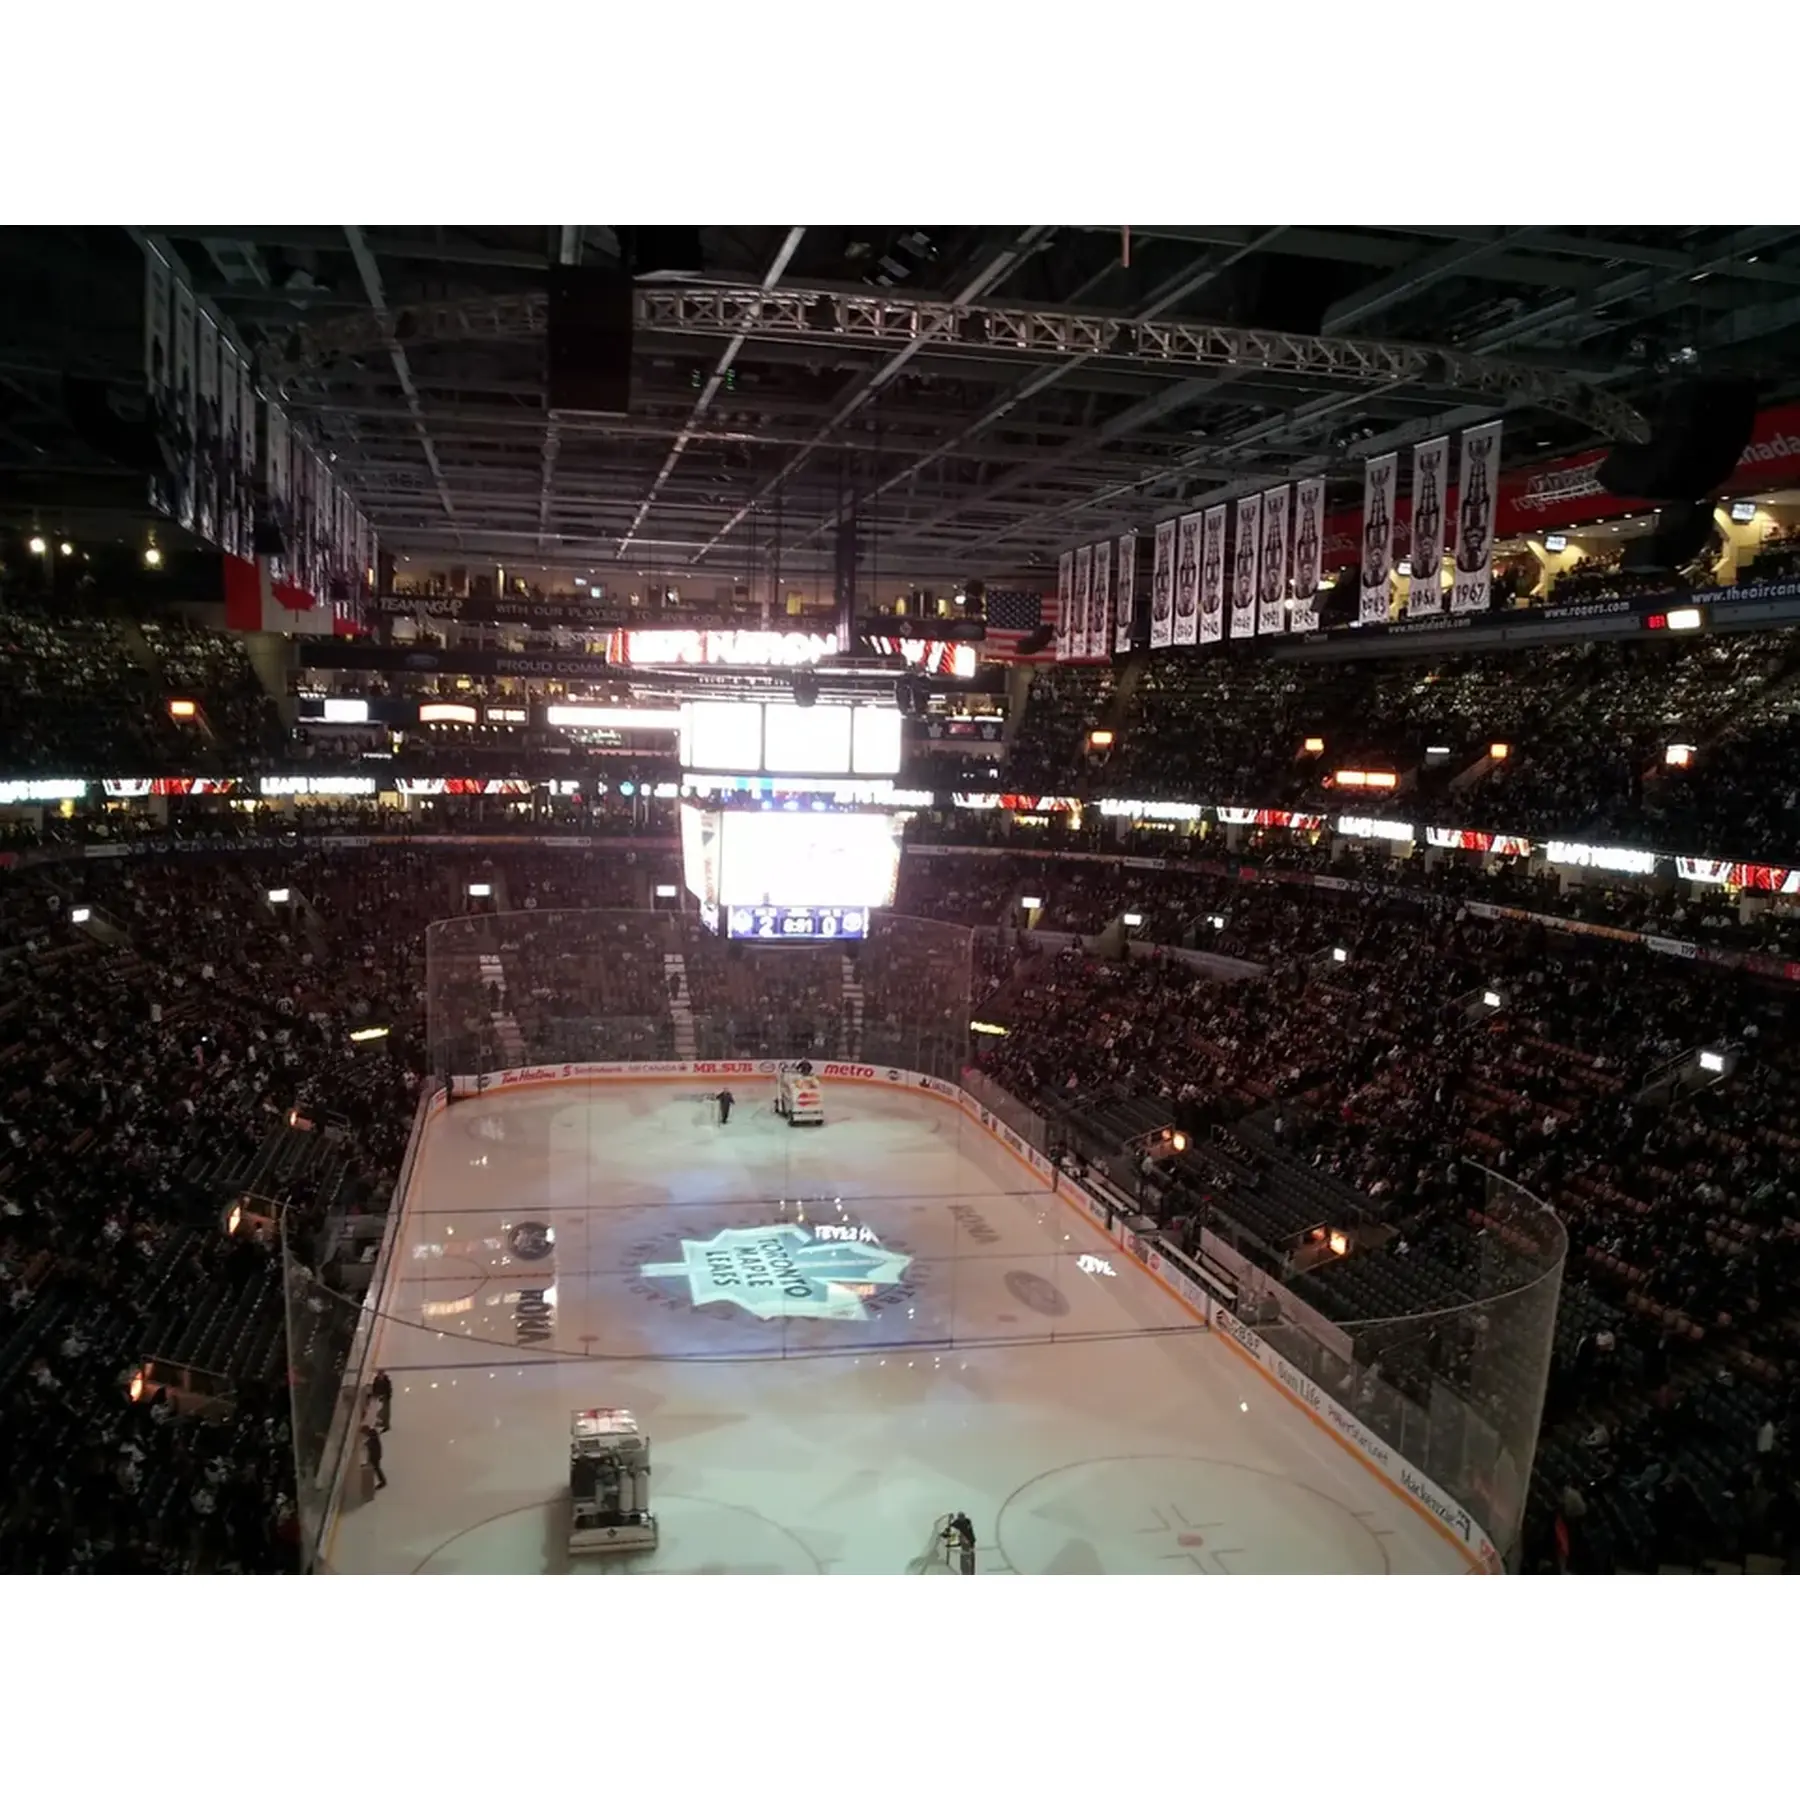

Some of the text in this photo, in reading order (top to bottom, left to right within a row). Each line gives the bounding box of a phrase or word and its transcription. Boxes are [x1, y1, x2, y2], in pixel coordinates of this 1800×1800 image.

[1454, 582, 1486, 605] 1967
[496, 604, 528, 616] WITH
[534, 605, 563, 617] OUR
[1544, 600, 1630, 619] www.rogers.com
[496, 659, 552, 672] PROUD
[758, 915, 774, 937] 2
[822, 916, 837, 936] 0
[502, 1071, 518, 1084] Tim
[824, 1063, 875, 1079] metro
[705, 1250, 741, 1288] LEAFS
[732, 1245, 773, 1289] MAPLE
[757, 1237, 813, 1299] TORONTO
[1300, 1379, 1321, 1412] Life
